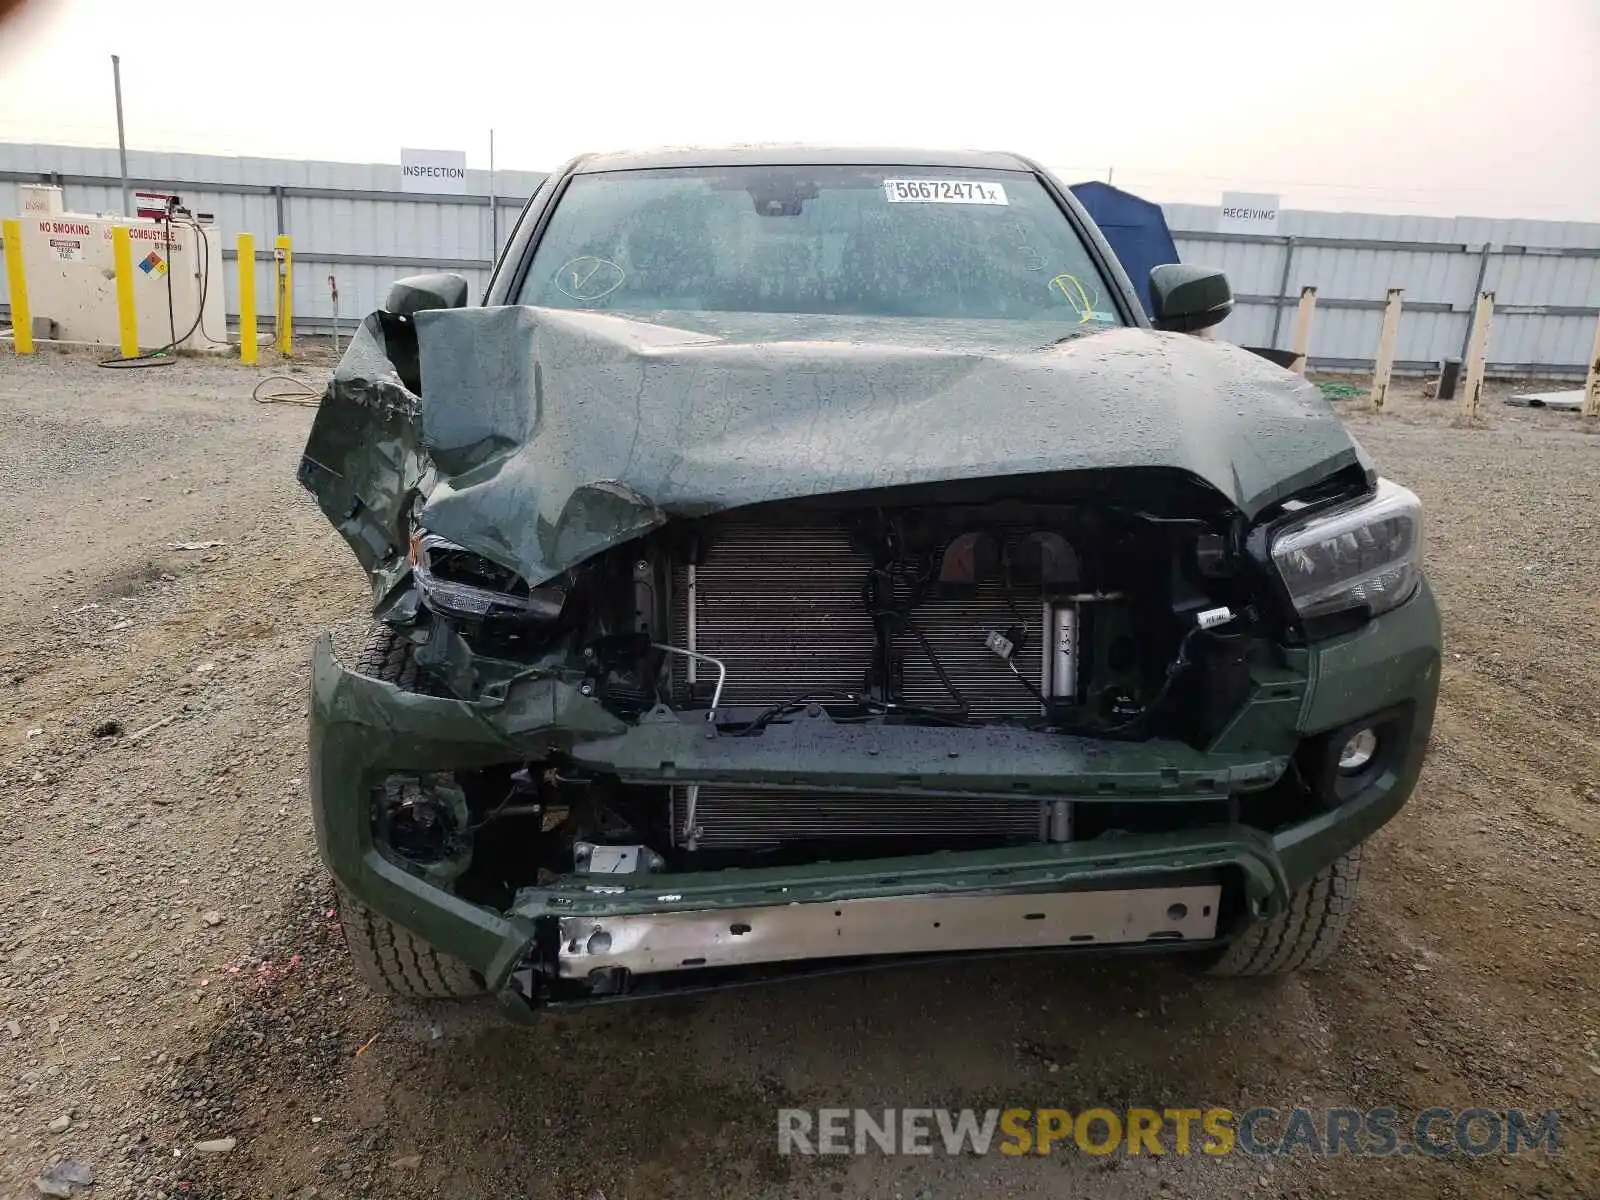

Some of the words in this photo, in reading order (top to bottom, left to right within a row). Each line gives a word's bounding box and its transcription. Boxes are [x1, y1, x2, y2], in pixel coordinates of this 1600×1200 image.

[403, 166, 464, 179] INSPECTION
[1222, 207, 1275, 220] RECEIVING
[39, 222, 51, 232] NO
[53, 223, 90, 235] SMOKING
